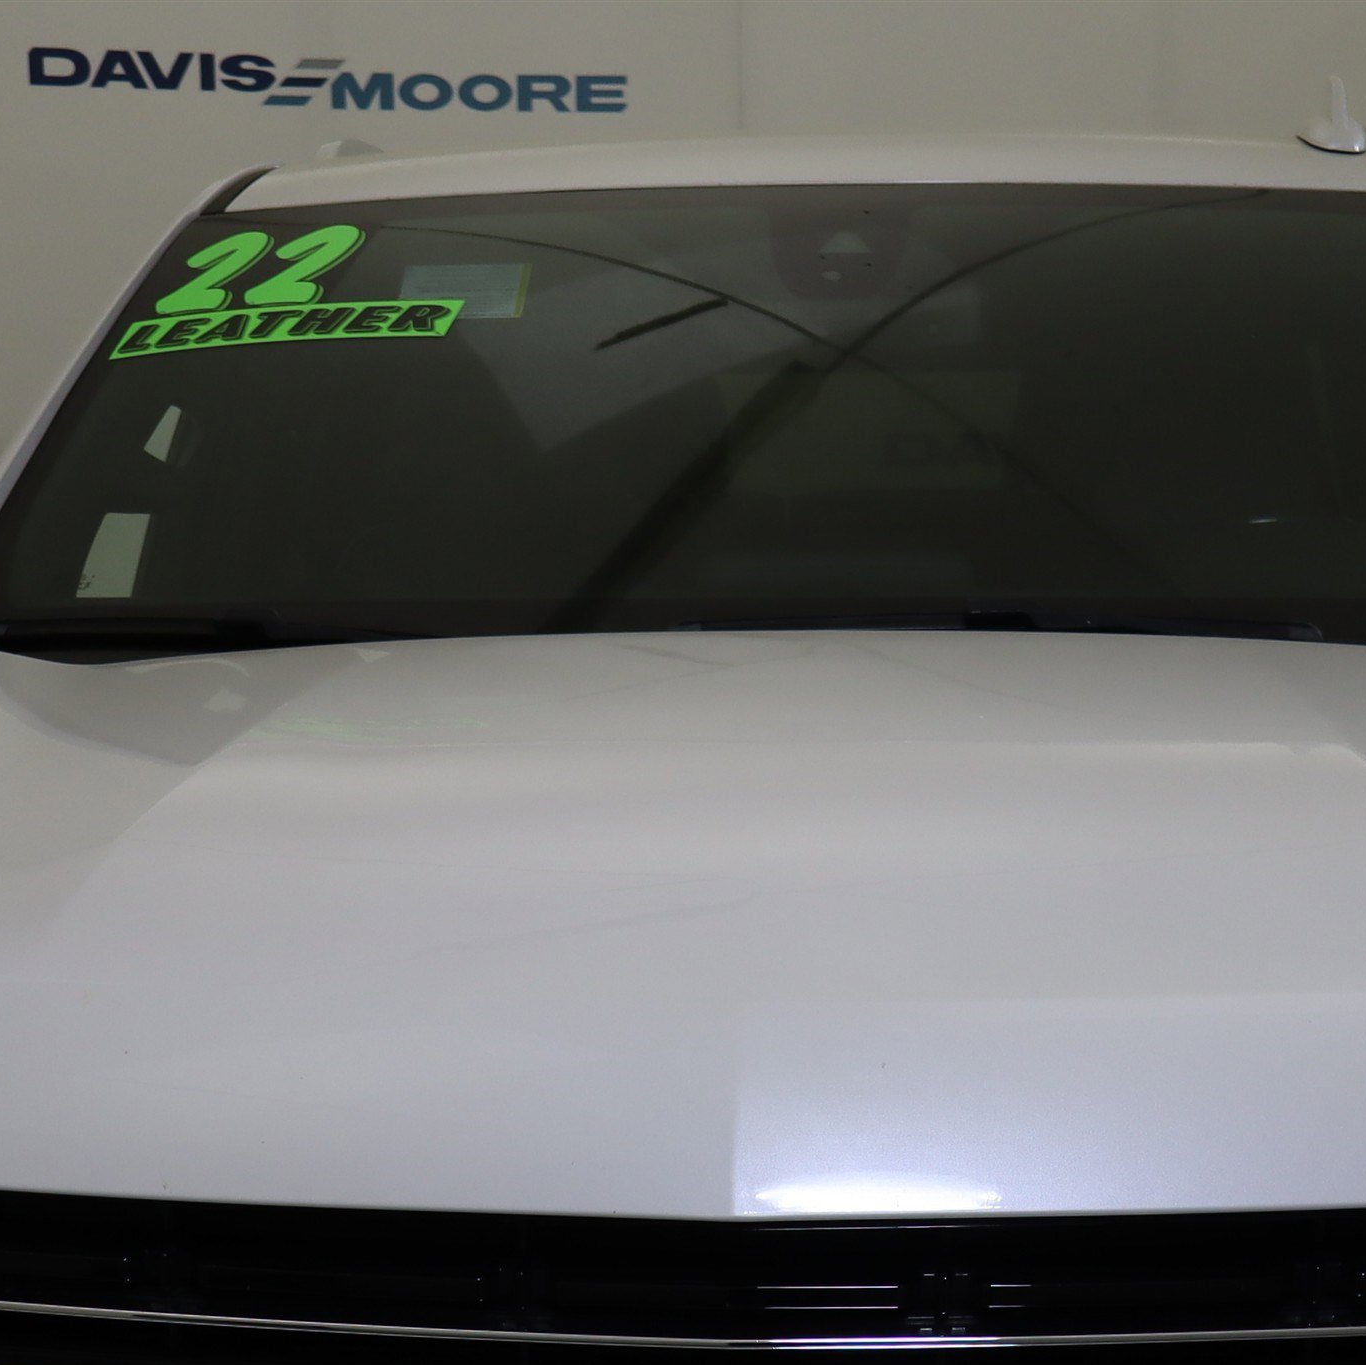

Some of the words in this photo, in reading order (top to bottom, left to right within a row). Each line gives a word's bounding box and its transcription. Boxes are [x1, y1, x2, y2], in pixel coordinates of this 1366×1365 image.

[27, 46, 276, 92] DAVIS
[331, 72, 627, 112] MOORE
[154, 224, 366, 316] 22
[116, 304, 452, 355] LEATHER
